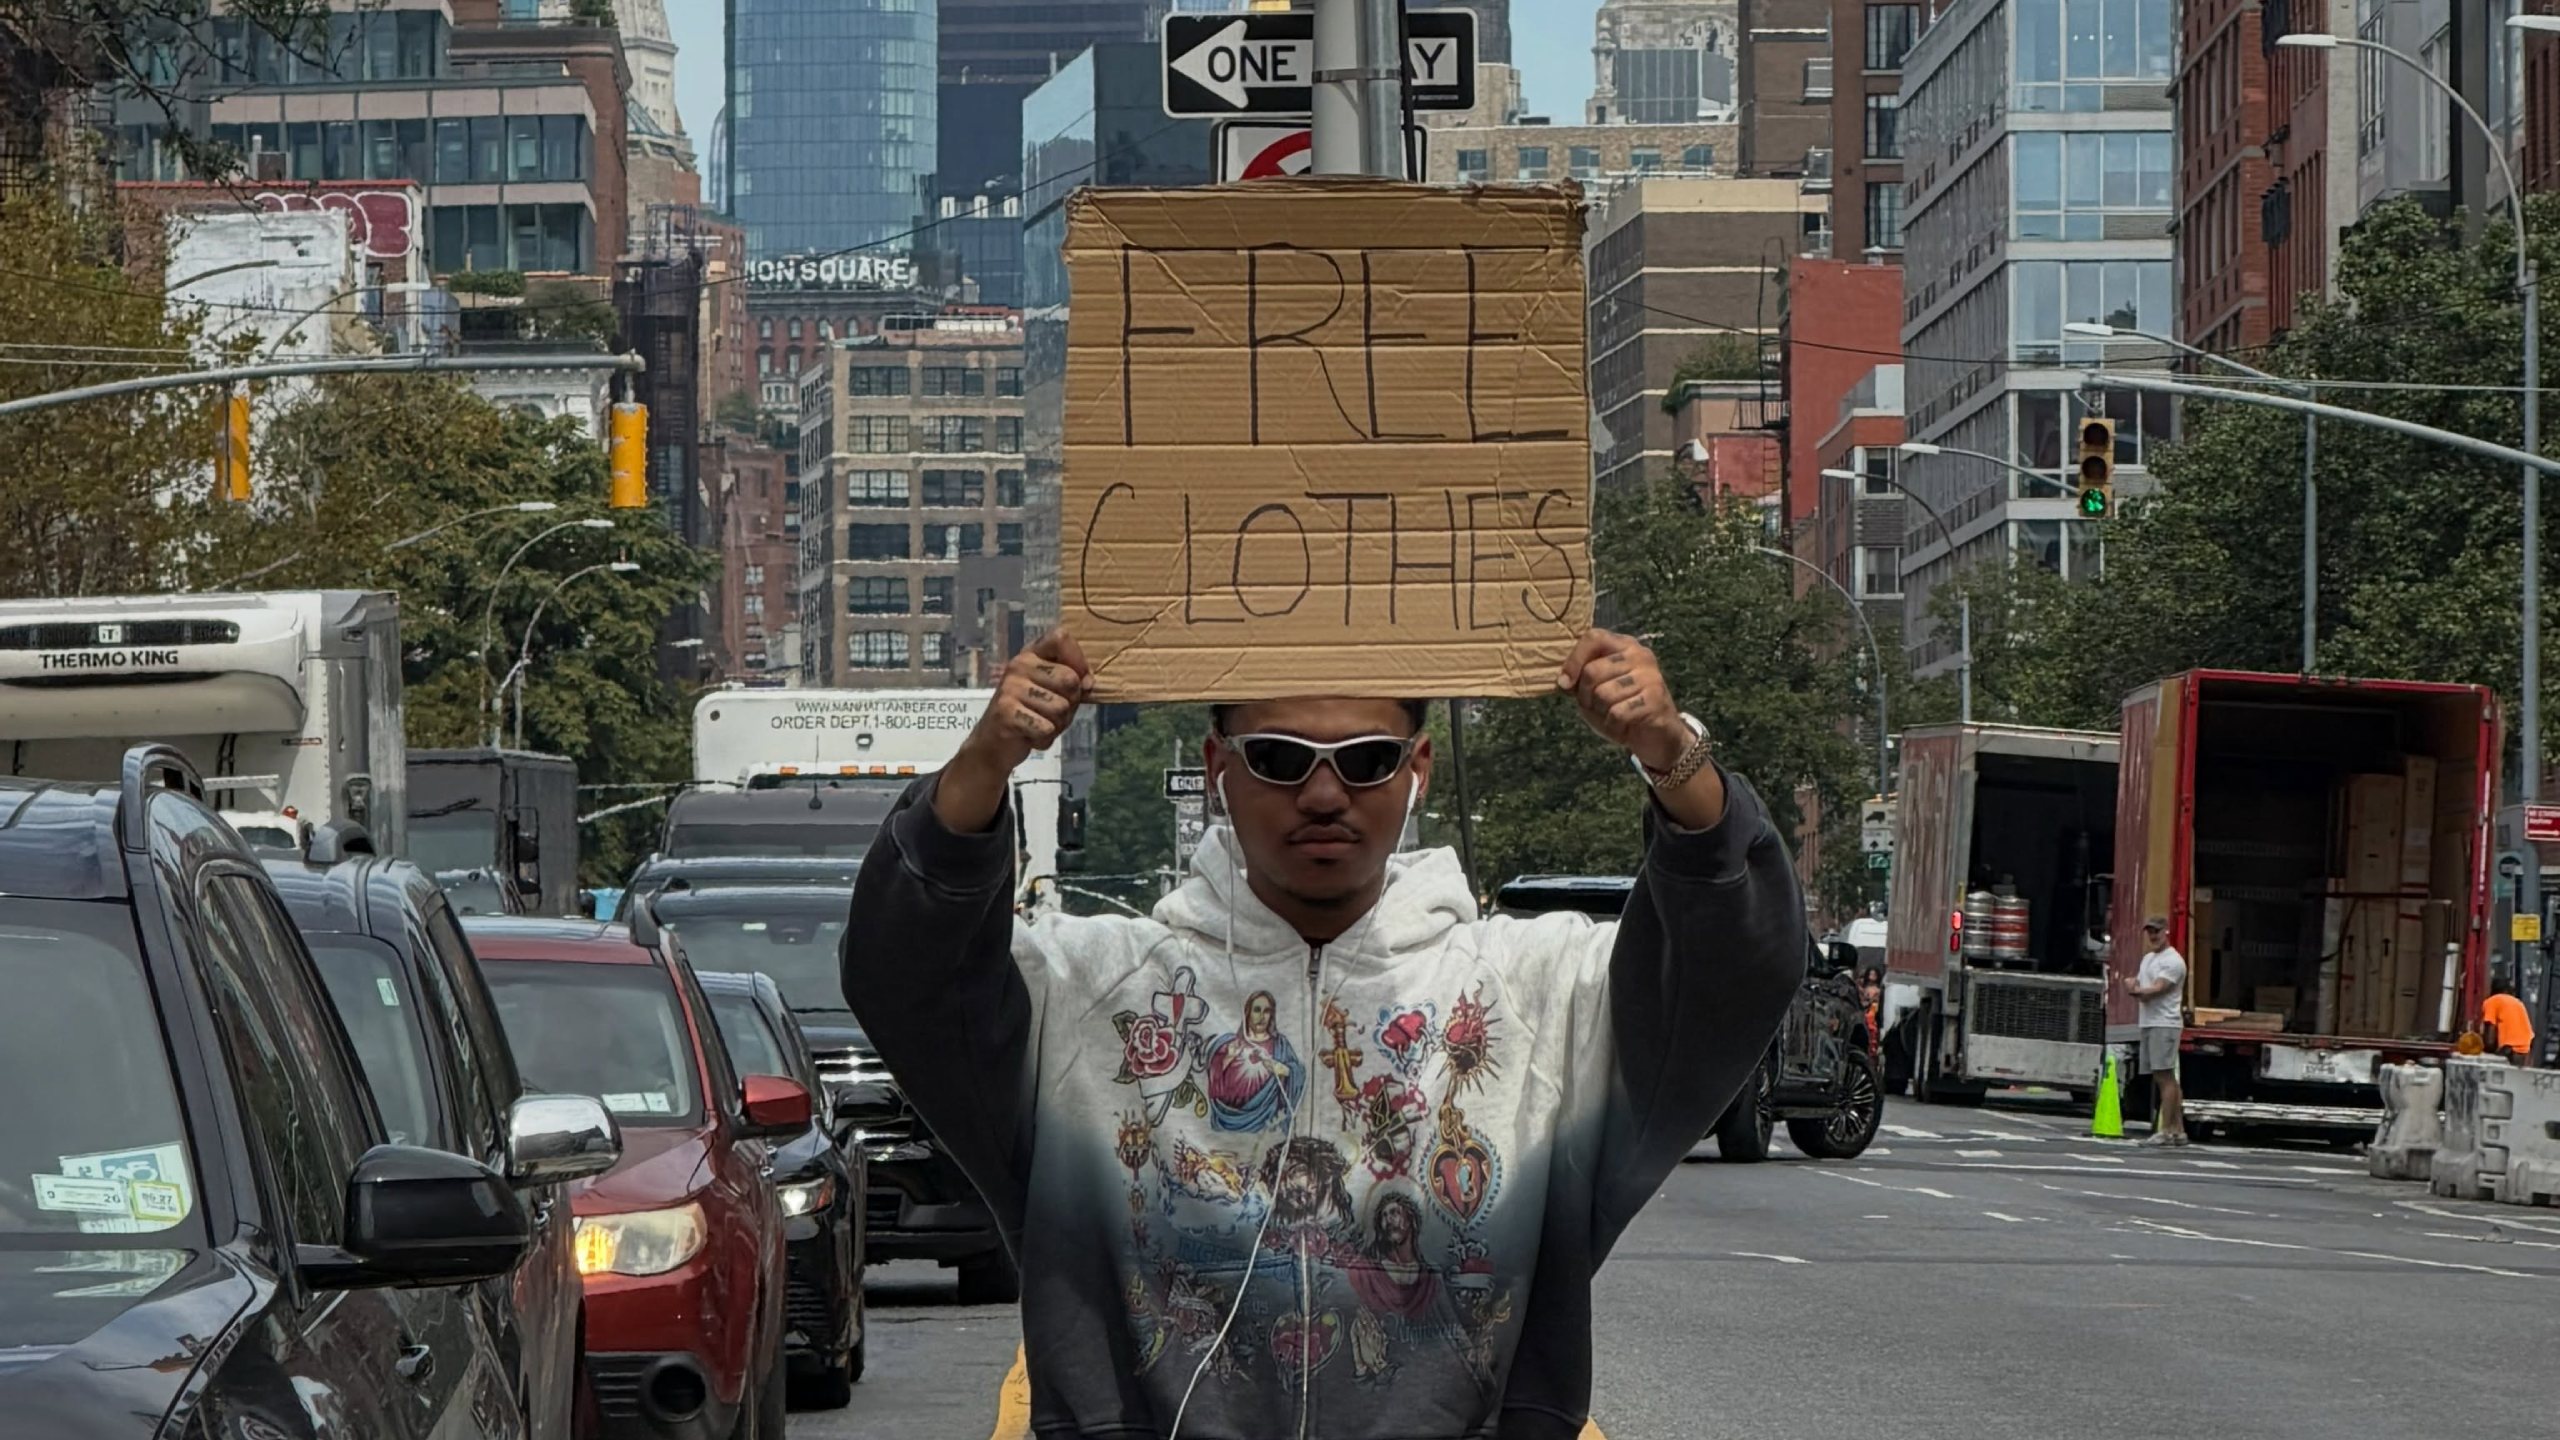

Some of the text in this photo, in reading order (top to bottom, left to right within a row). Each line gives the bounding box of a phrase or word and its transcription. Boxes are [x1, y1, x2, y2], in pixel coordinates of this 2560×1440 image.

[1207, 45, 1297, 82] ONE
[745, 256, 910, 284] ION SQUARE
[1123, 243, 1569, 447] FREE
[1081, 482, 1577, 631] CLOTHES
[39, 650, 179, 669] THERMO KING
[795, 701, 967, 714] WWW.MANHATTANBEER.COM
[771, 715, 826, 730] ORDER
[874, 714, 978, 730] 1-800-BEER-IN
